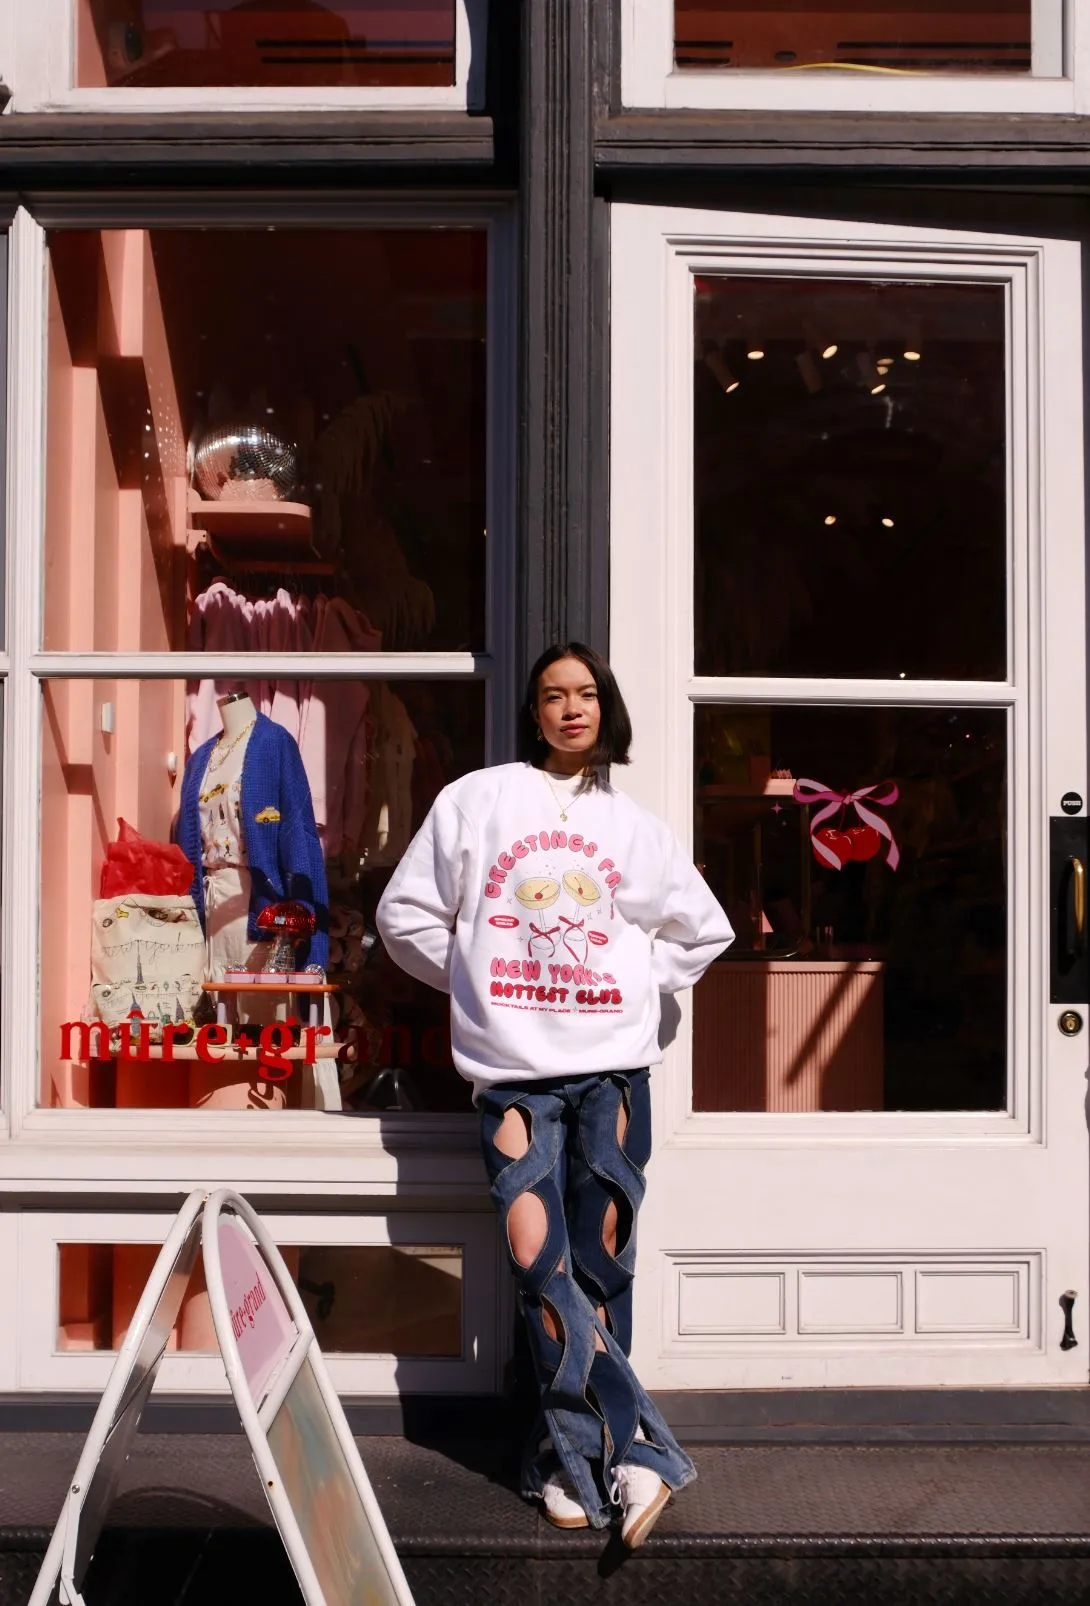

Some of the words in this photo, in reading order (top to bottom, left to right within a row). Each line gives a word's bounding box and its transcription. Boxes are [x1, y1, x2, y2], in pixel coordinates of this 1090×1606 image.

[484, 830, 598, 898] GREETINGS
[490, 957, 541, 982] NEW
[489, 981, 570, 1003] HOTTEST
[575, 988, 623, 1005] CLUB
